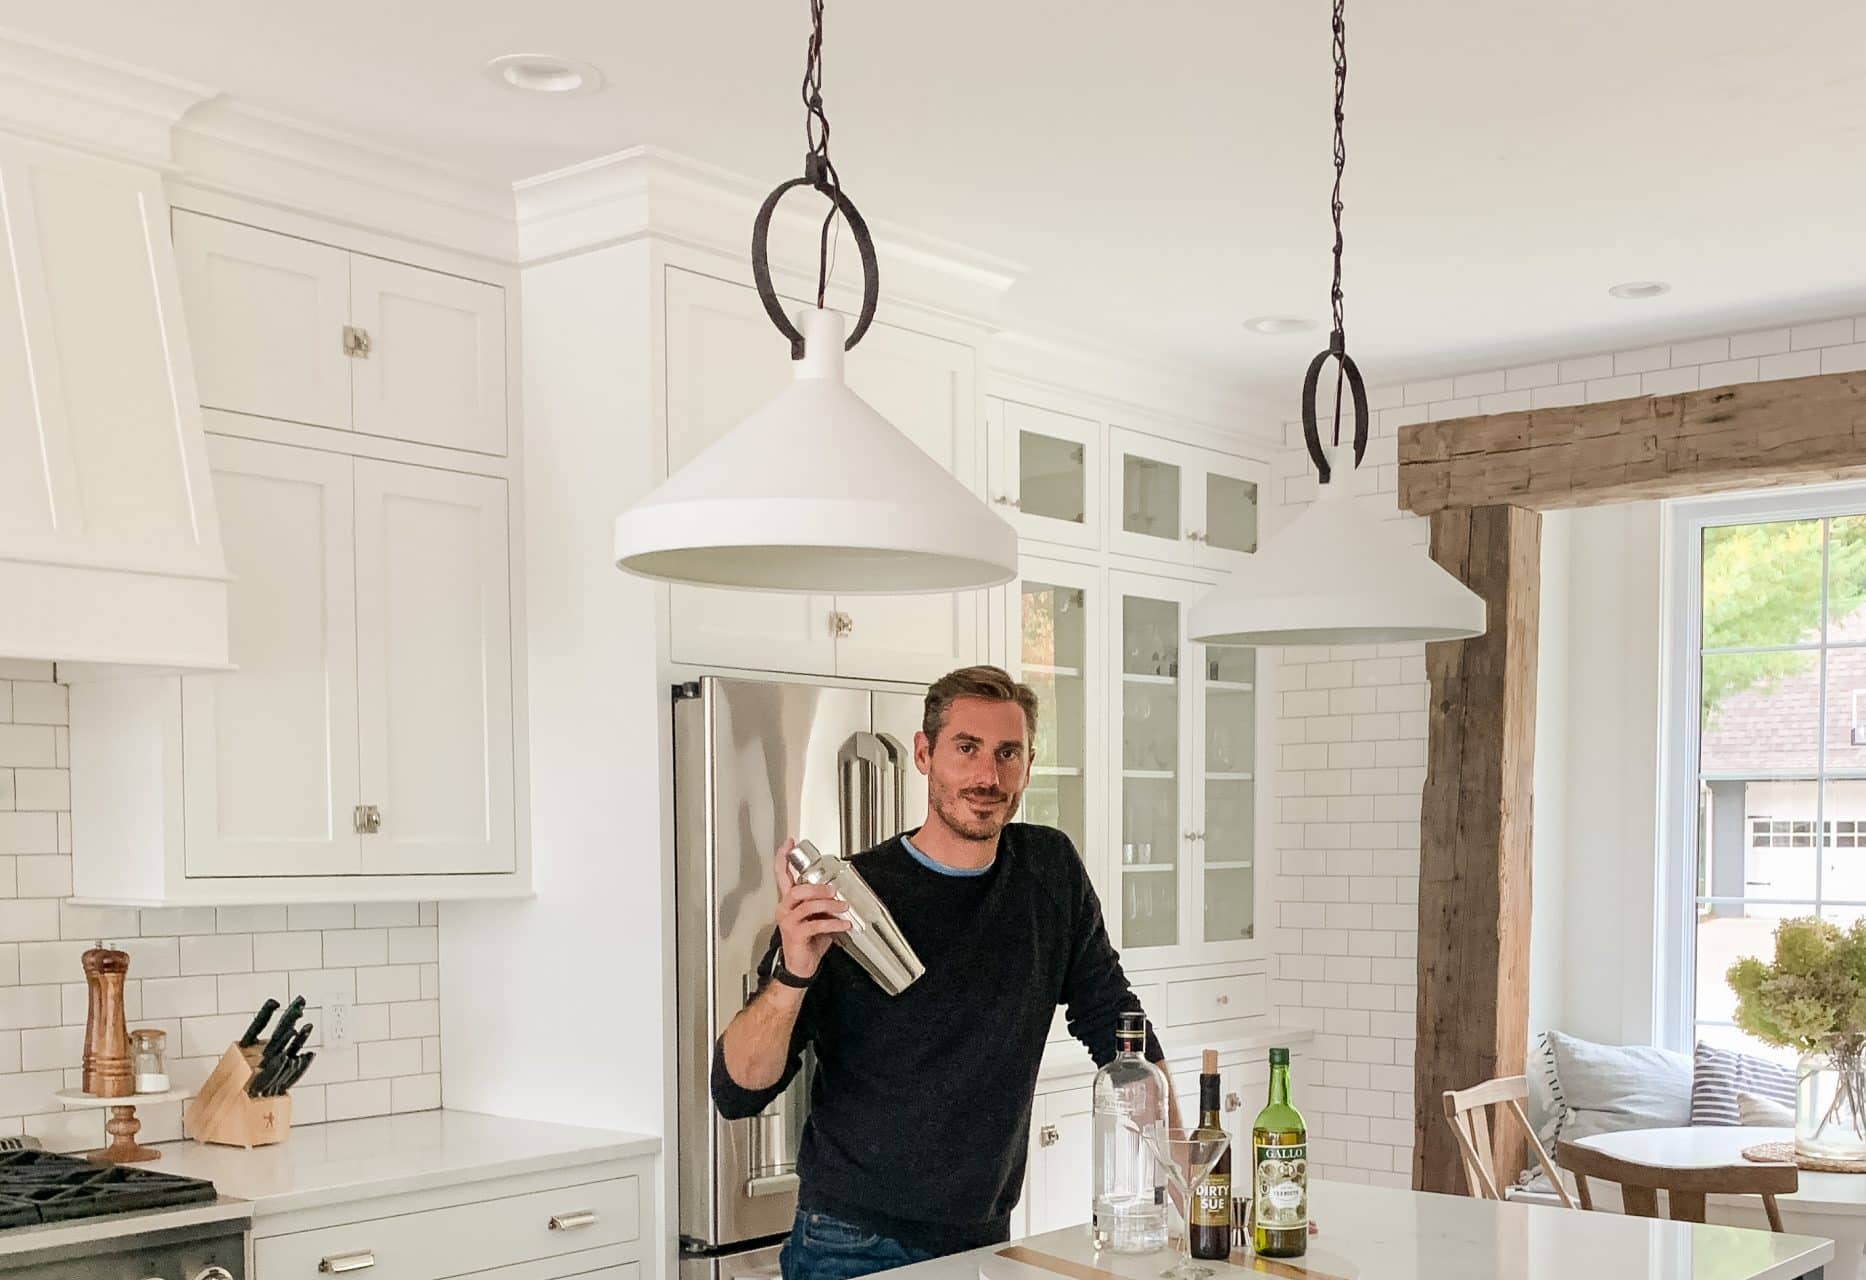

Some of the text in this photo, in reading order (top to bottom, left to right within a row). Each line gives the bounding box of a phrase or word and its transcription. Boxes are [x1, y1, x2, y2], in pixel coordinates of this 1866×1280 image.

[1265, 1148, 1303, 1159] GALLO
[1196, 1185, 1230, 1196] DIRTY
[1200, 1198, 1225, 1210] SUE
